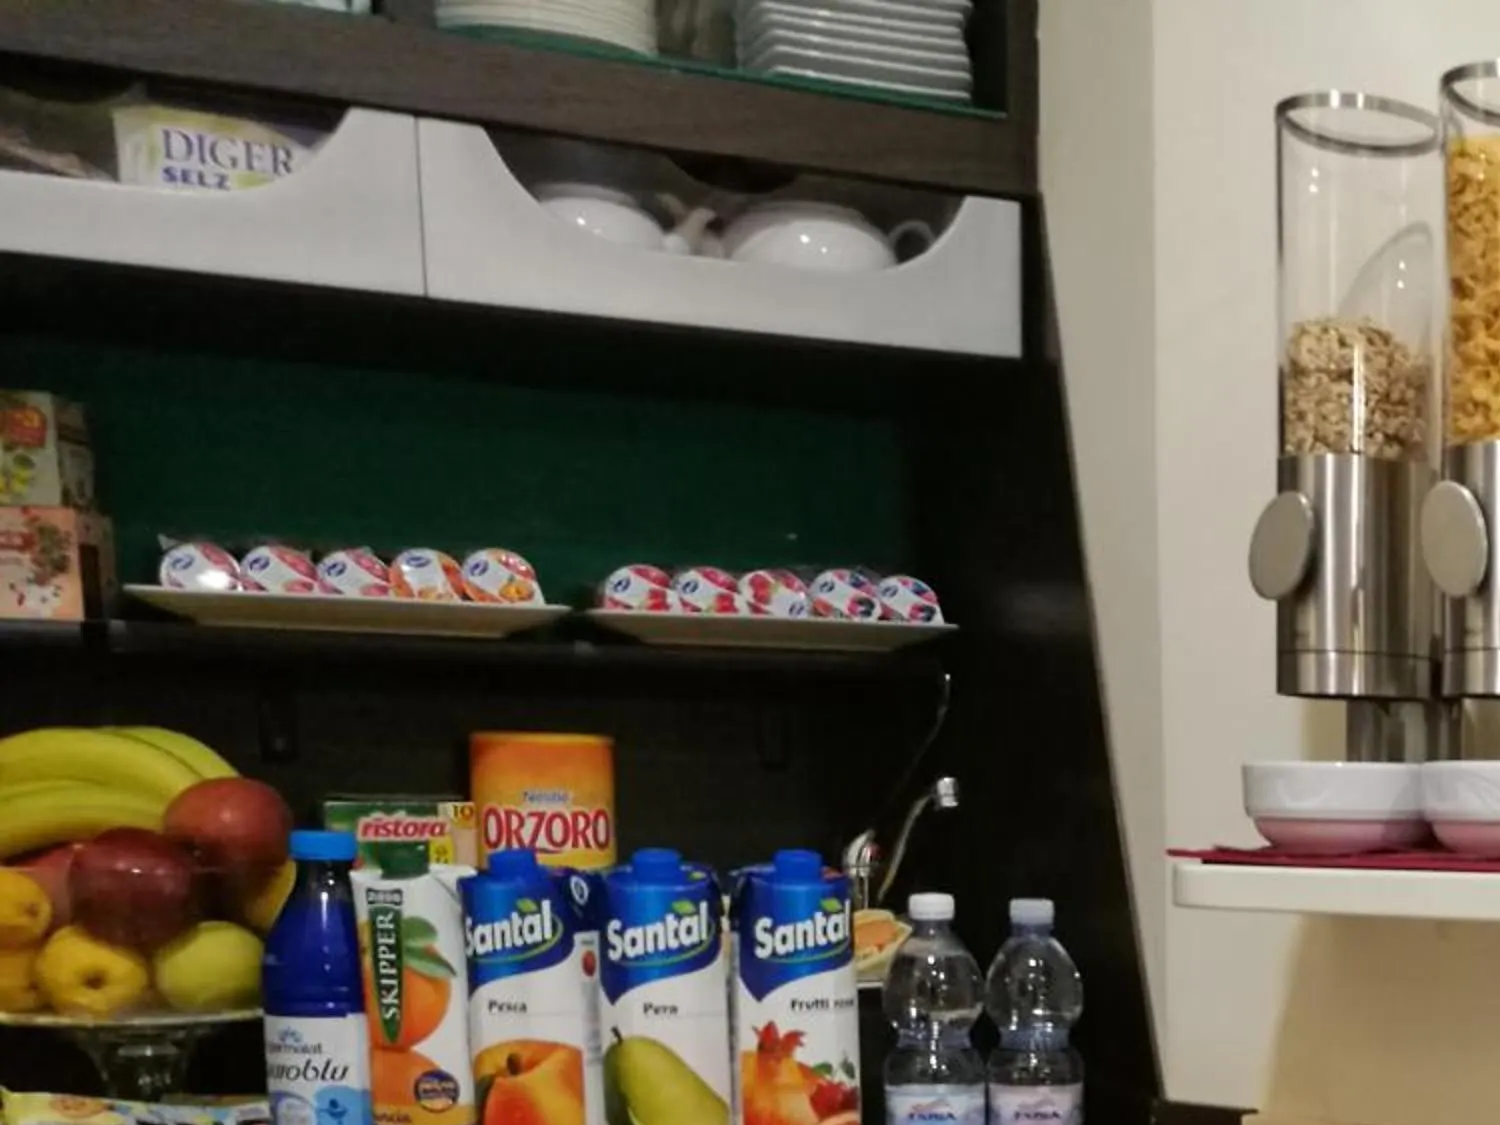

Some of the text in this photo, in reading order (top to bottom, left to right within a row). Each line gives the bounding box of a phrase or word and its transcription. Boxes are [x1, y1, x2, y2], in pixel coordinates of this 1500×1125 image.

[162, 127, 293, 176] DIGER
[162, 165, 231, 191] SELZ
[361, 814, 448, 838] ristora
[482, 807, 611, 850] ORZORO
[465, 899, 553, 956] Santal
[606, 901, 708, 961] Santal
[754, 899, 851, 959] Santal
[375, 910, 399, 1021] SKIPPER
[488, 999, 527, 1014] Pesca
[643, 1002, 678, 1016] Pera
[791, 998, 829, 1011] Frutti
